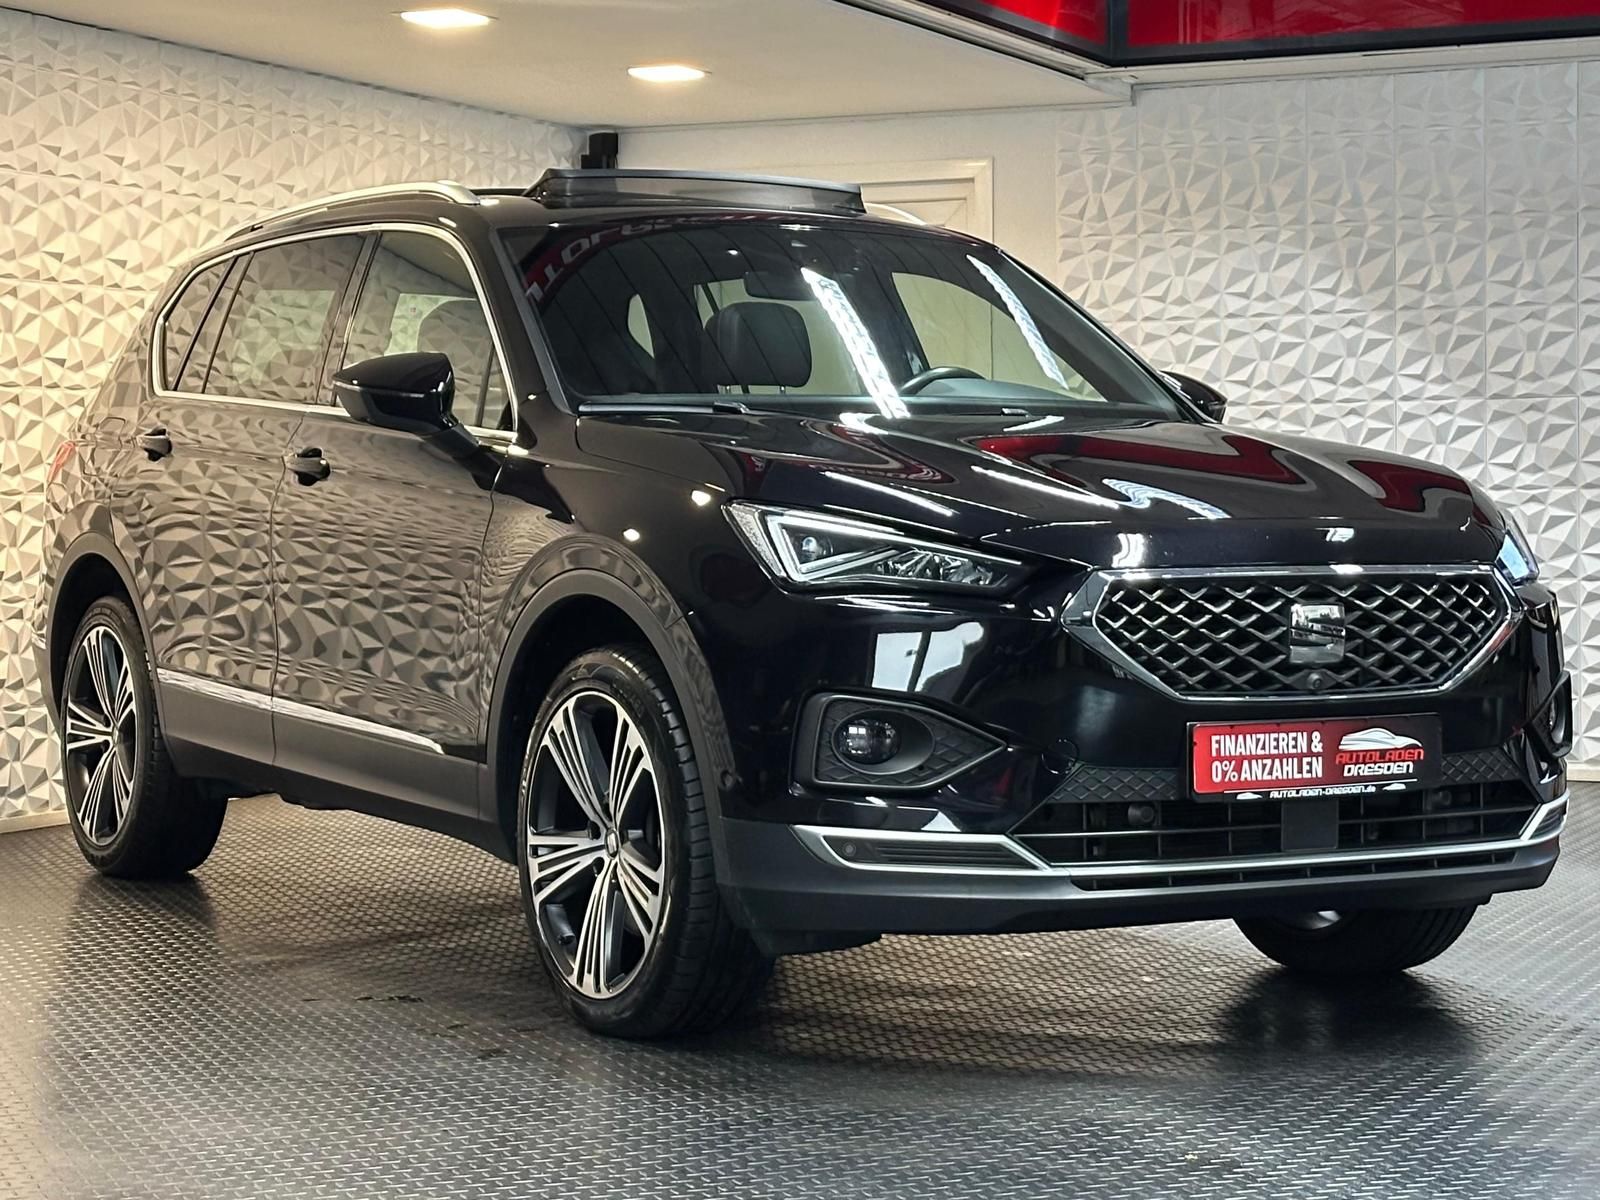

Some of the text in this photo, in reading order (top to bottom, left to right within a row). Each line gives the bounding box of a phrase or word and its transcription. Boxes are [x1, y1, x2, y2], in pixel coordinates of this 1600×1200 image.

[1211, 731, 1323, 757] FINANZIEREN &
[1336, 748, 1424, 765] AUTOLADEN
[1212, 757, 1323, 783] 0% ANZAHLEN
[1343, 761, 1414, 777] DRESDEN
